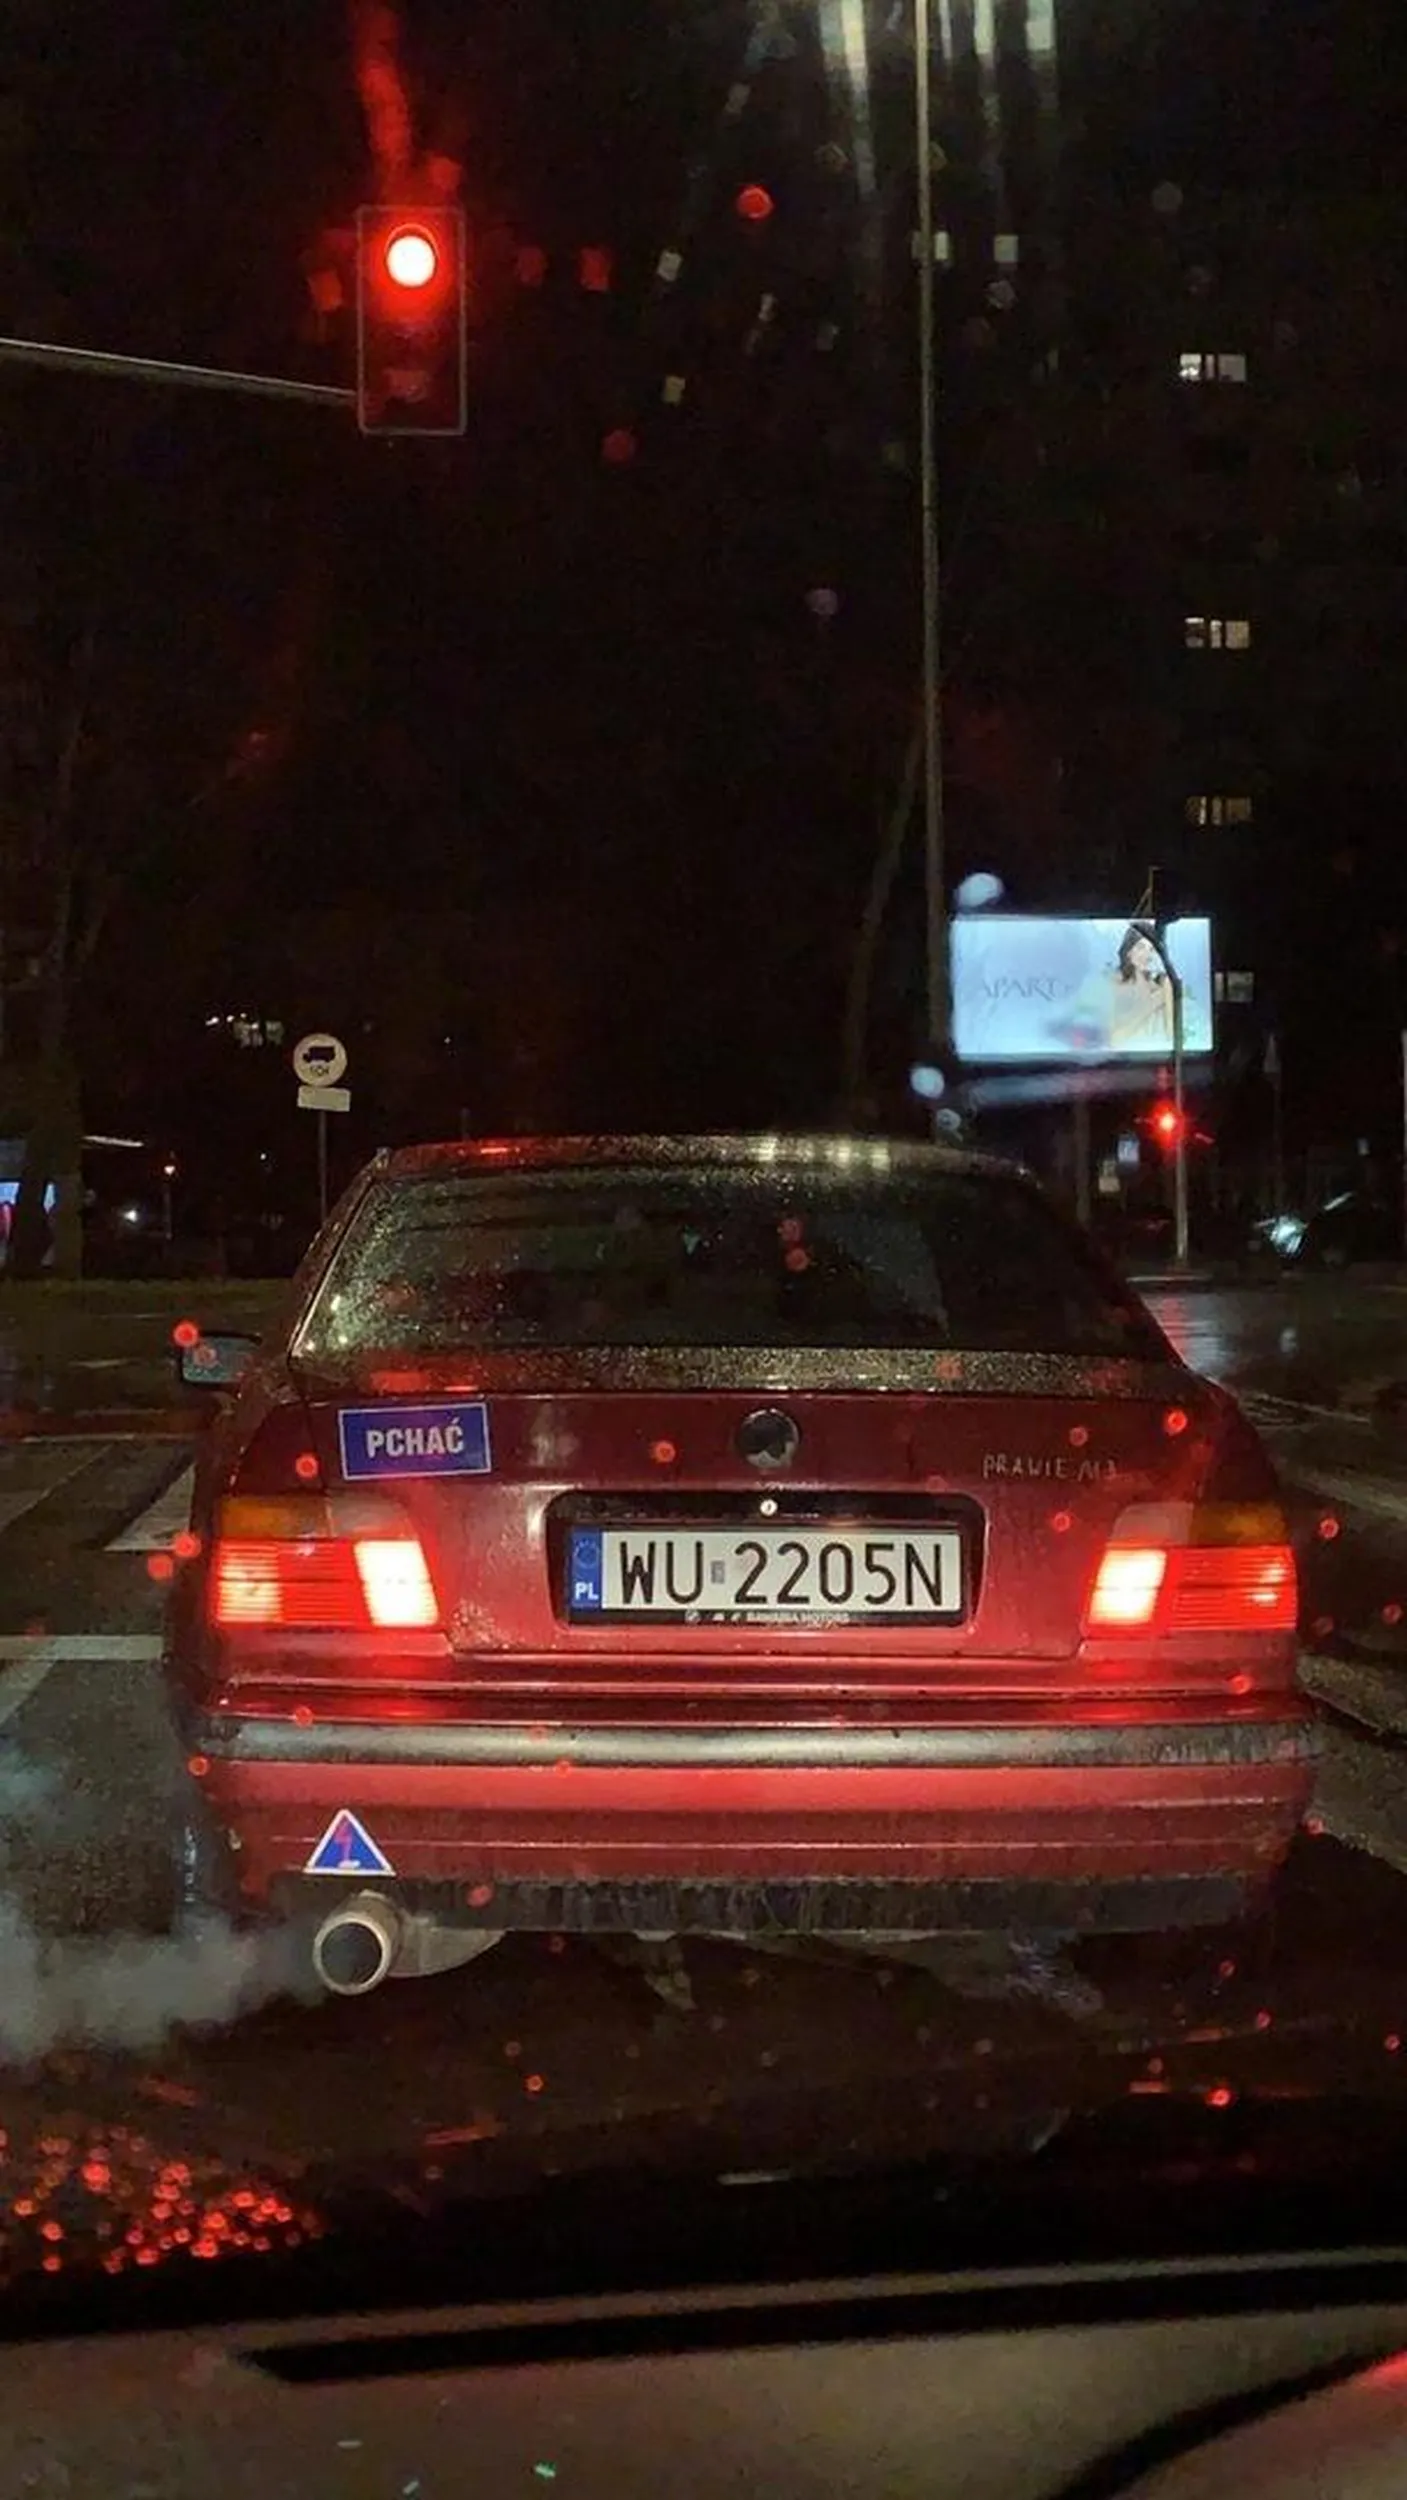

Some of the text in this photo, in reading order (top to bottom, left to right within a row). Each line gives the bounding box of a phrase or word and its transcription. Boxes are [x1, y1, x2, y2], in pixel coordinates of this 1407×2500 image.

[982, 977, 1064, 1000] APART
[366, 1417, 465, 1459] PCHAĆ
[982, 1453, 1068, 1480] PRAWIE
[619, 1540, 943, 1606] WU 2205N
[575, 1584, 599, 1601] PL
